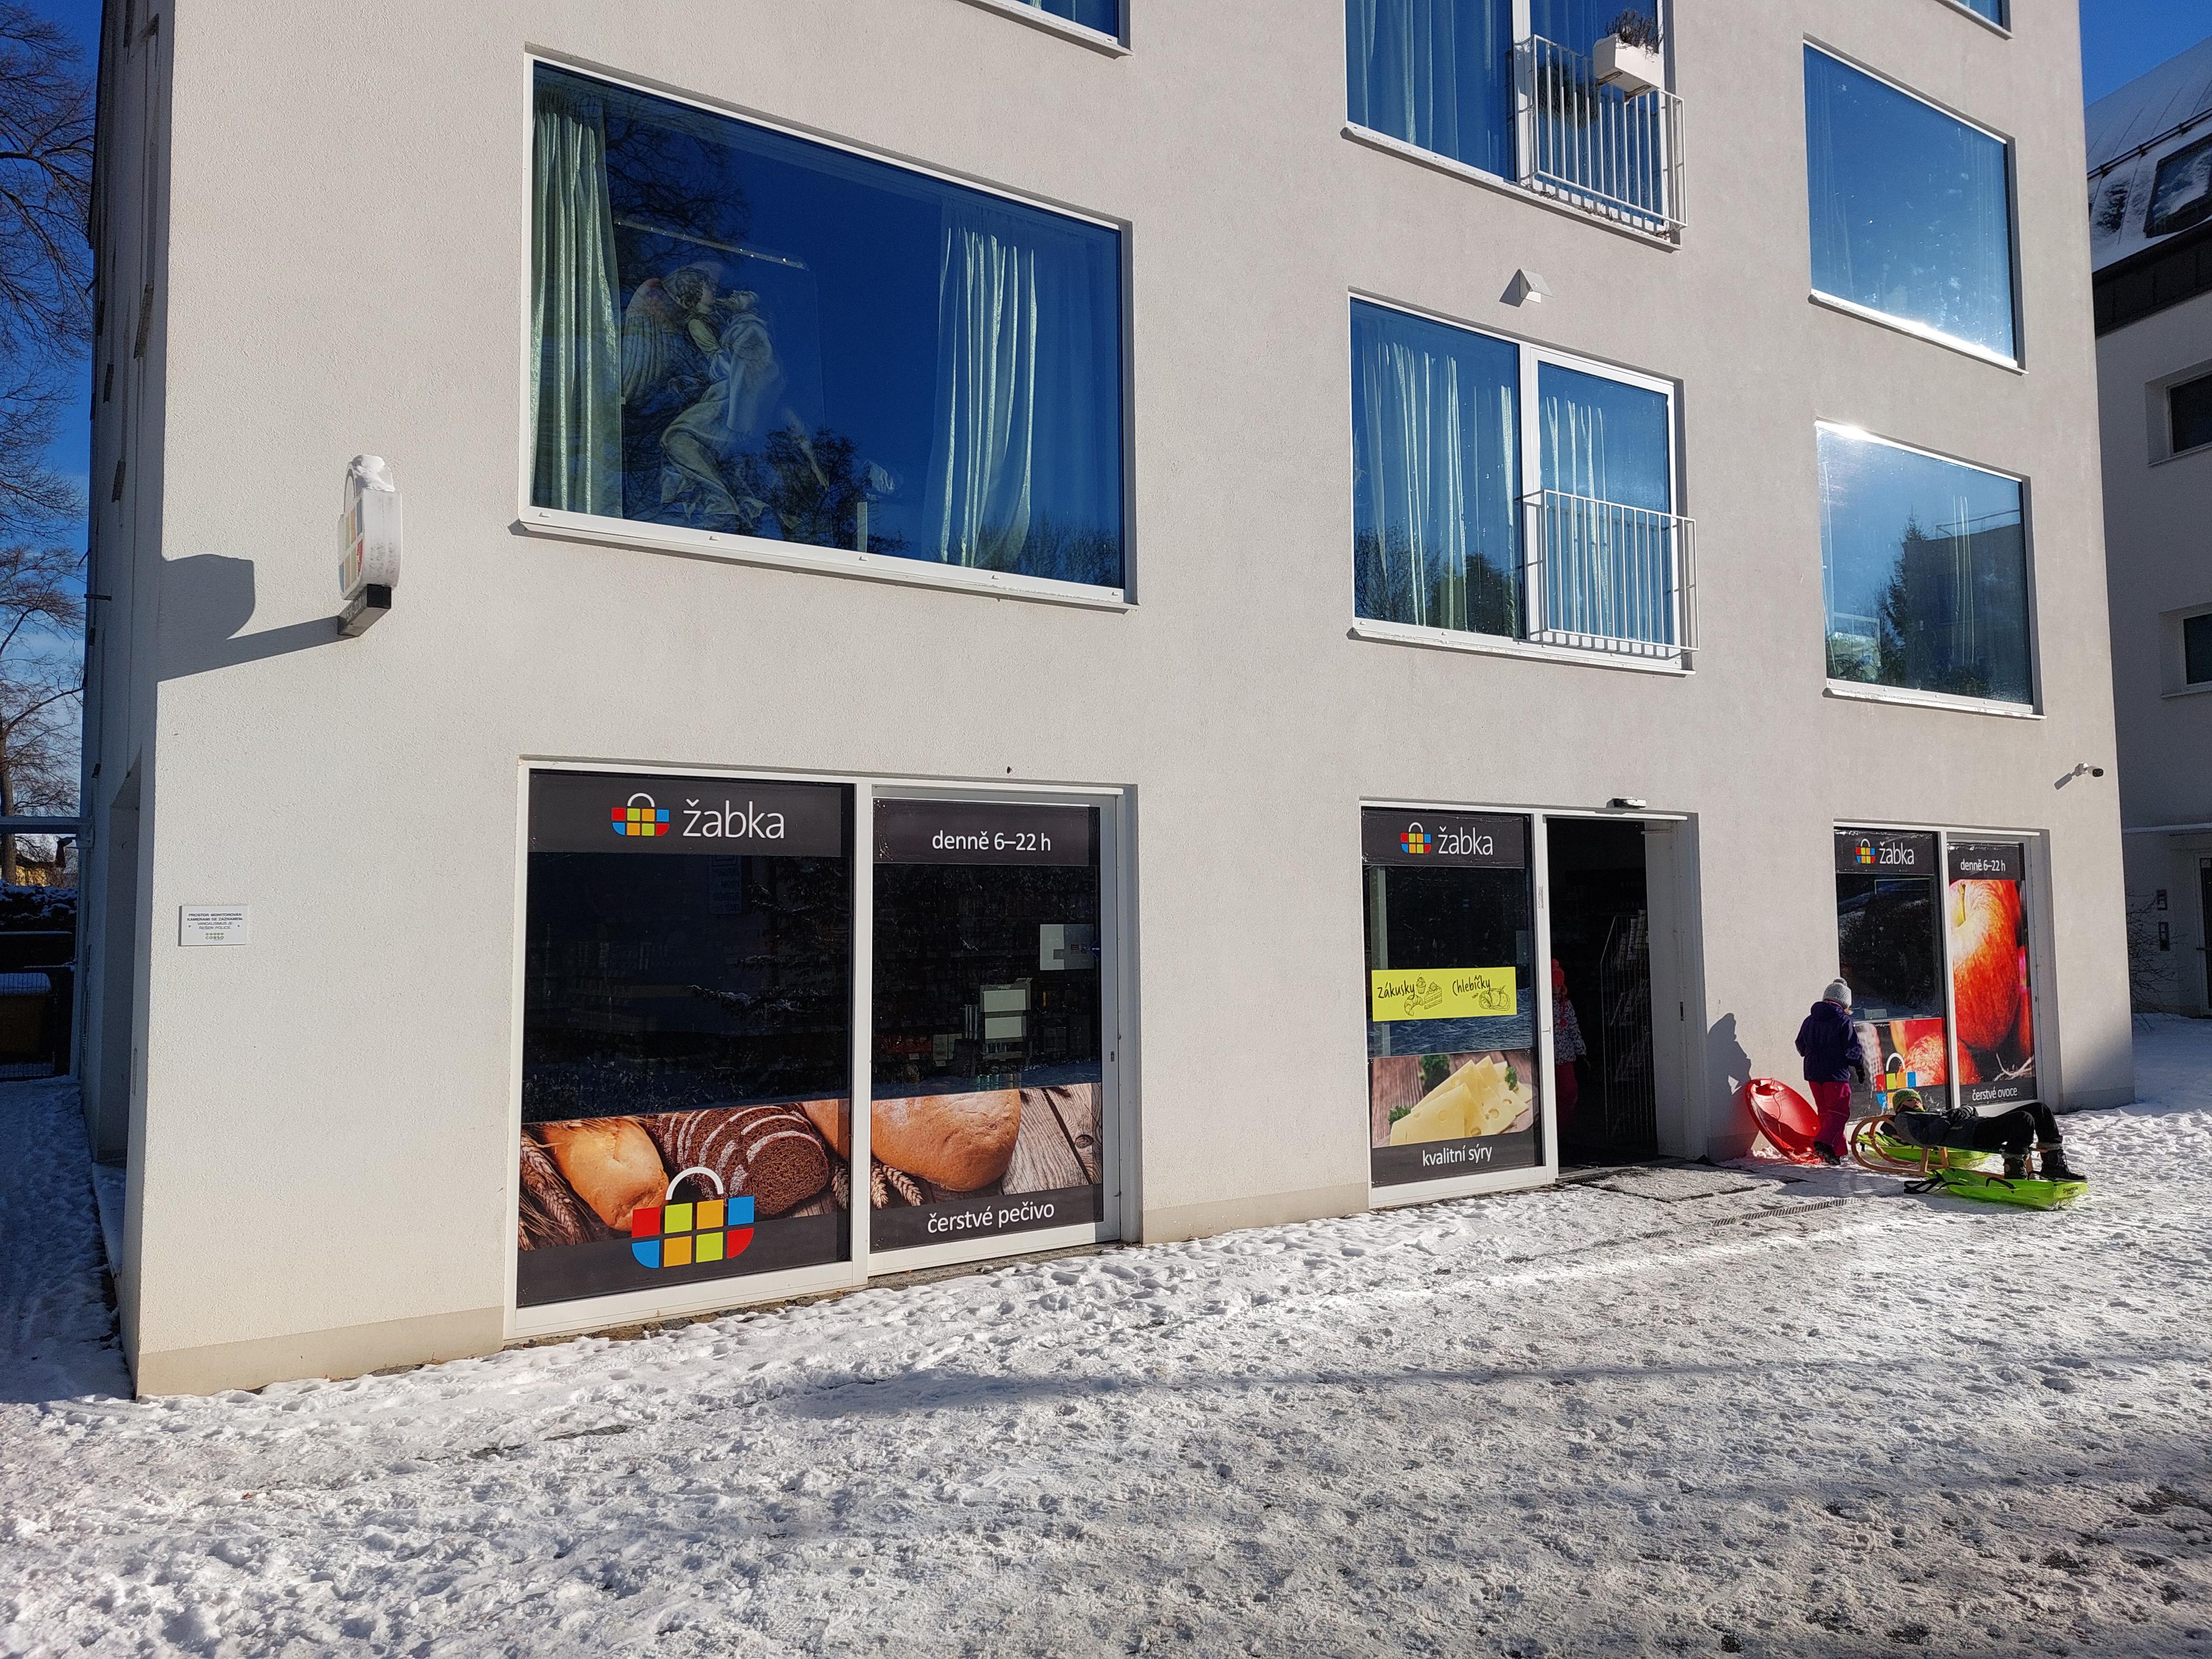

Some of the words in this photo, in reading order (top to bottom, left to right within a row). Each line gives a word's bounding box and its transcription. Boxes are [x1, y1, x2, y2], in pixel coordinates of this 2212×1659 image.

[682, 799, 784, 839] žabka
[932, 830, 989, 850] denně
[1041, 833, 1051, 851] h
[1438, 826, 1493, 855] žabka
[1879, 841, 1914, 865] žabka
[1960, 858, 1982, 872] denně
[2001, 860, 2006, 872] h
[1376, 980, 1416, 1000] Zákusky
[1452, 974, 1491, 997] Chlebíčky
[1972, 1086, 1996, 1101] čerstvé
[1998, 1087, 2018, 1098] ovoce
[1422, 1145, 1466, 1167] kvalitní
[1469, 1143, 1493, 1164] sýry
[927, 1206, 993, 1233] čerstvé
[998, 1201, 1055, 1228] pečivo
